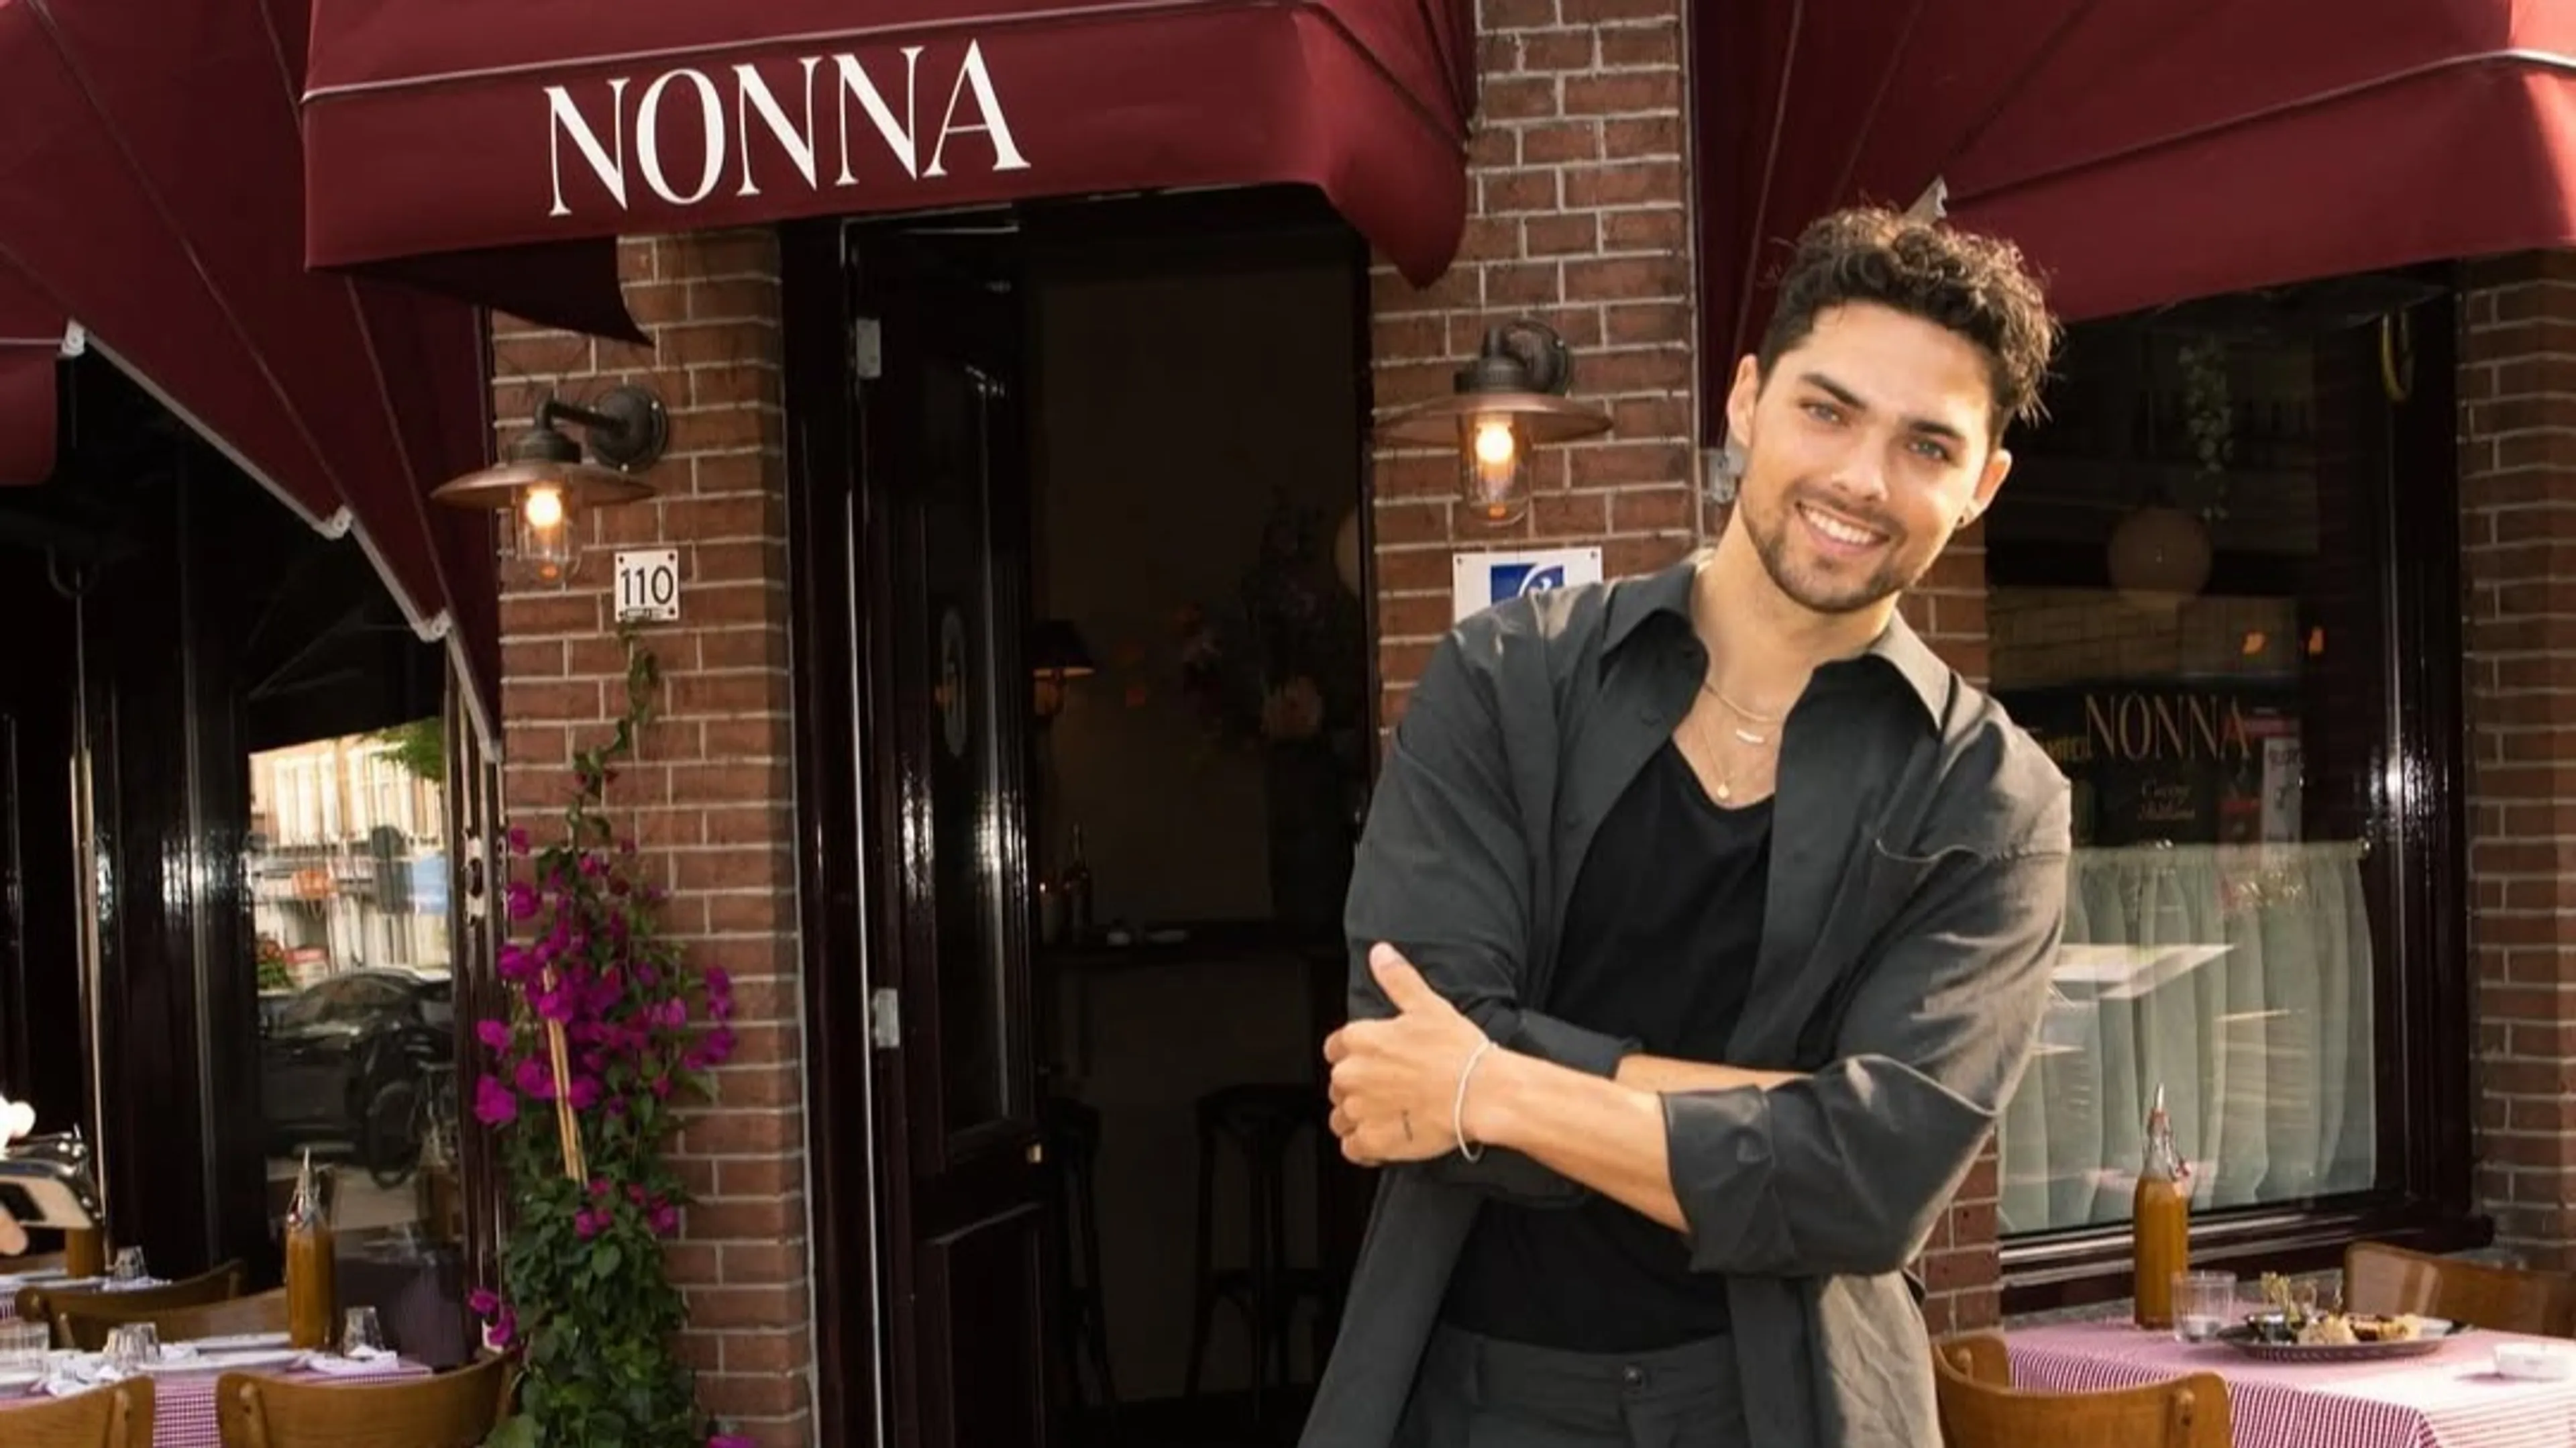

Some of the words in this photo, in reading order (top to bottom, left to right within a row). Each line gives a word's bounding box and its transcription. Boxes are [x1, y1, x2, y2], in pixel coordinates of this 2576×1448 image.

[543, 38, 1031, 217] NONNA
[621, 565, 674, 605] 110
[2084, 691, 2251, 761] NONNA
